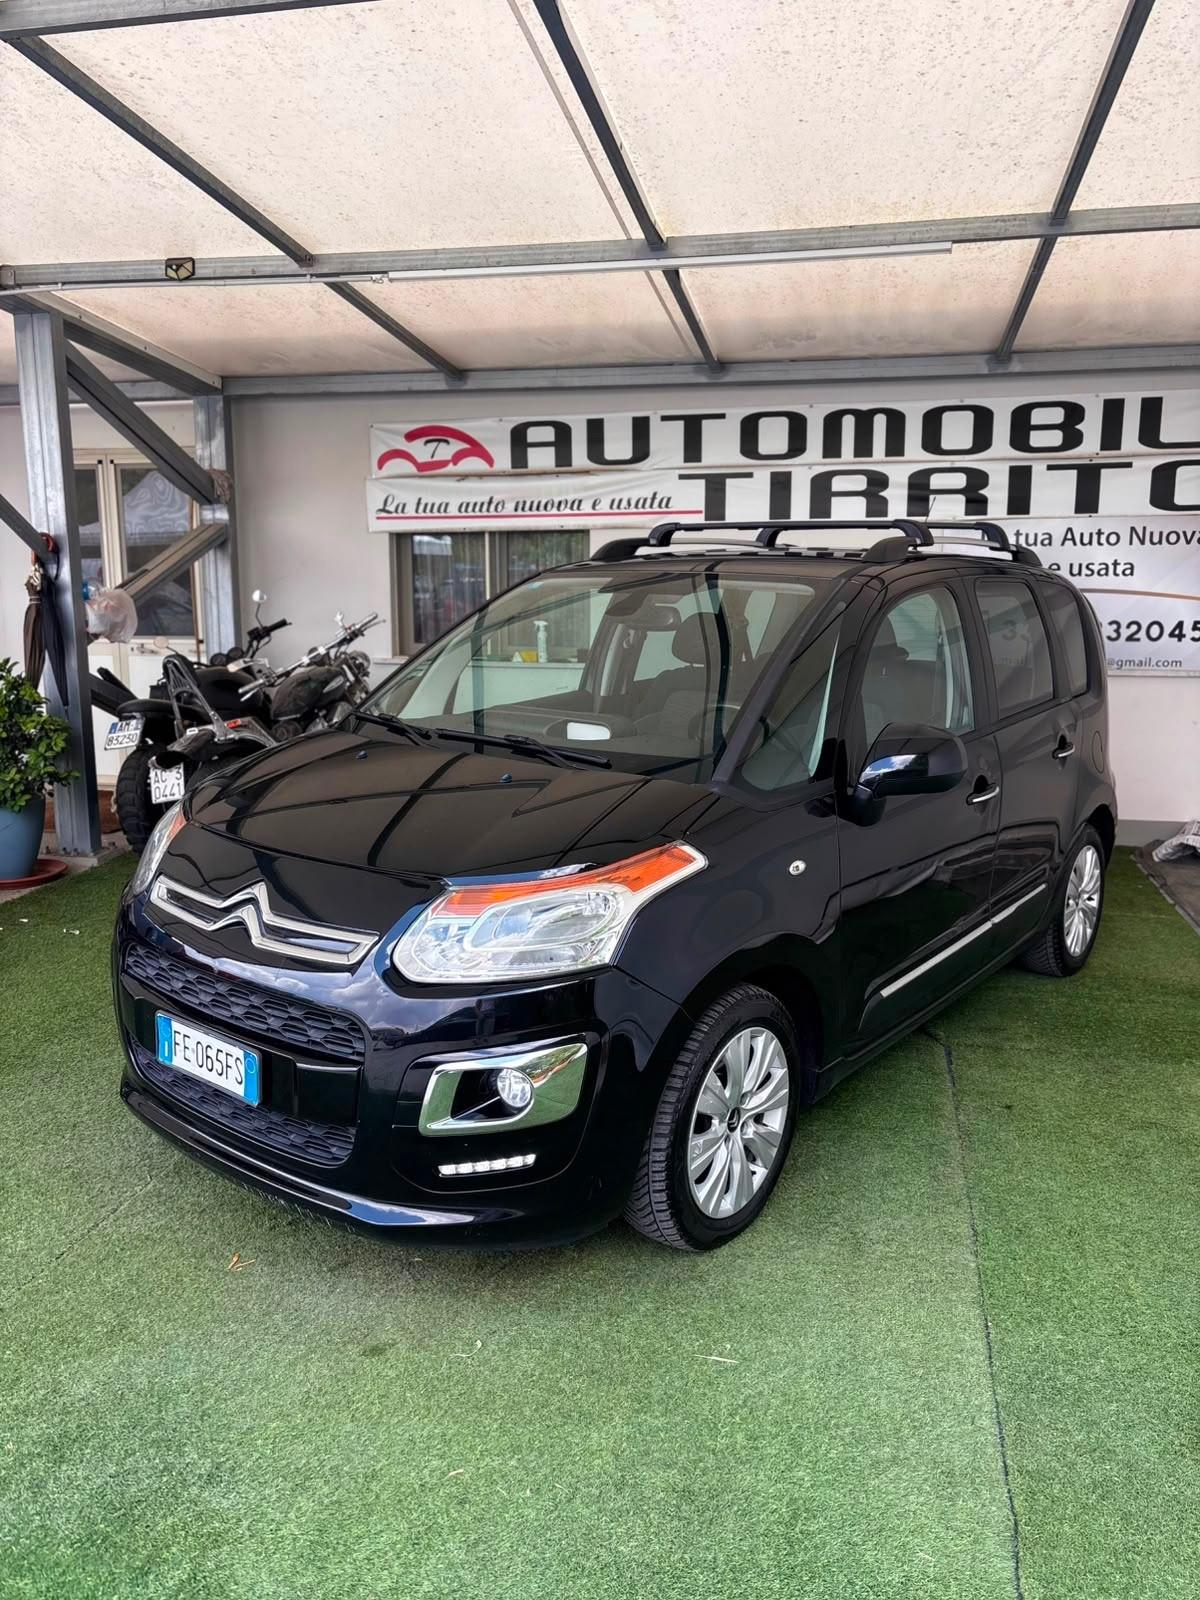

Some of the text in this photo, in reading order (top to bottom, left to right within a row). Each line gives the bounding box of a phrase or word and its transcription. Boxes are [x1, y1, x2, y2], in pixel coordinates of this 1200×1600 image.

[510, 396, 1200, 470] AUTOMOBIL
[376, 491, 673, 514] La tua auto nuova e usata
[1014, 529, 1052, 547] tua
[1061, 527, 1121, 547] Auto
[1069, 559, 1135, 577] usata
[1100, 620, 1200, 642] 32045
[153, 769, 167, 784] AC
[154, 783, 181, 800] 0441
